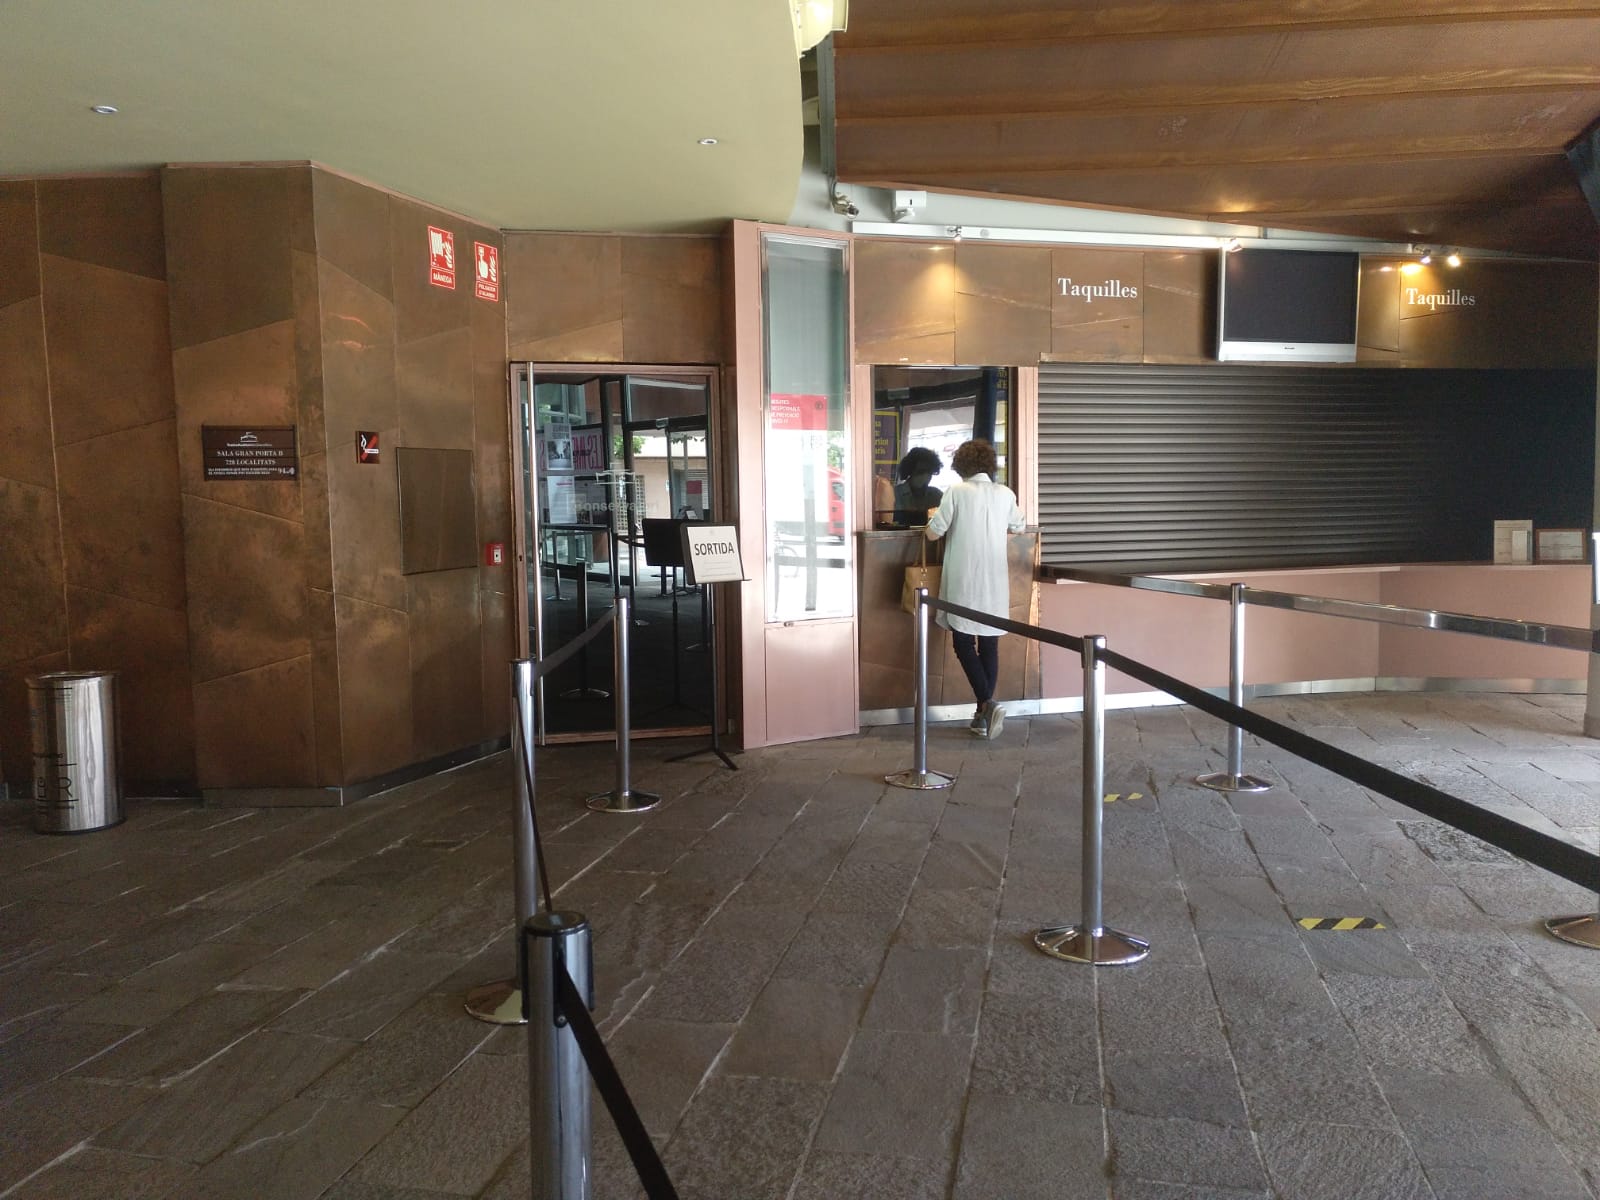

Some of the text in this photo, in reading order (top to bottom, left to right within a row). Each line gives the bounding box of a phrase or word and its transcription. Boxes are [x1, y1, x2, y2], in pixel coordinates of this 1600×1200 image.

[1057, 277, 1138, 303] Taquilles
[1405, 287, 1477, 311] Taquilles
[694, 541, 735, 556] SORTIDA
